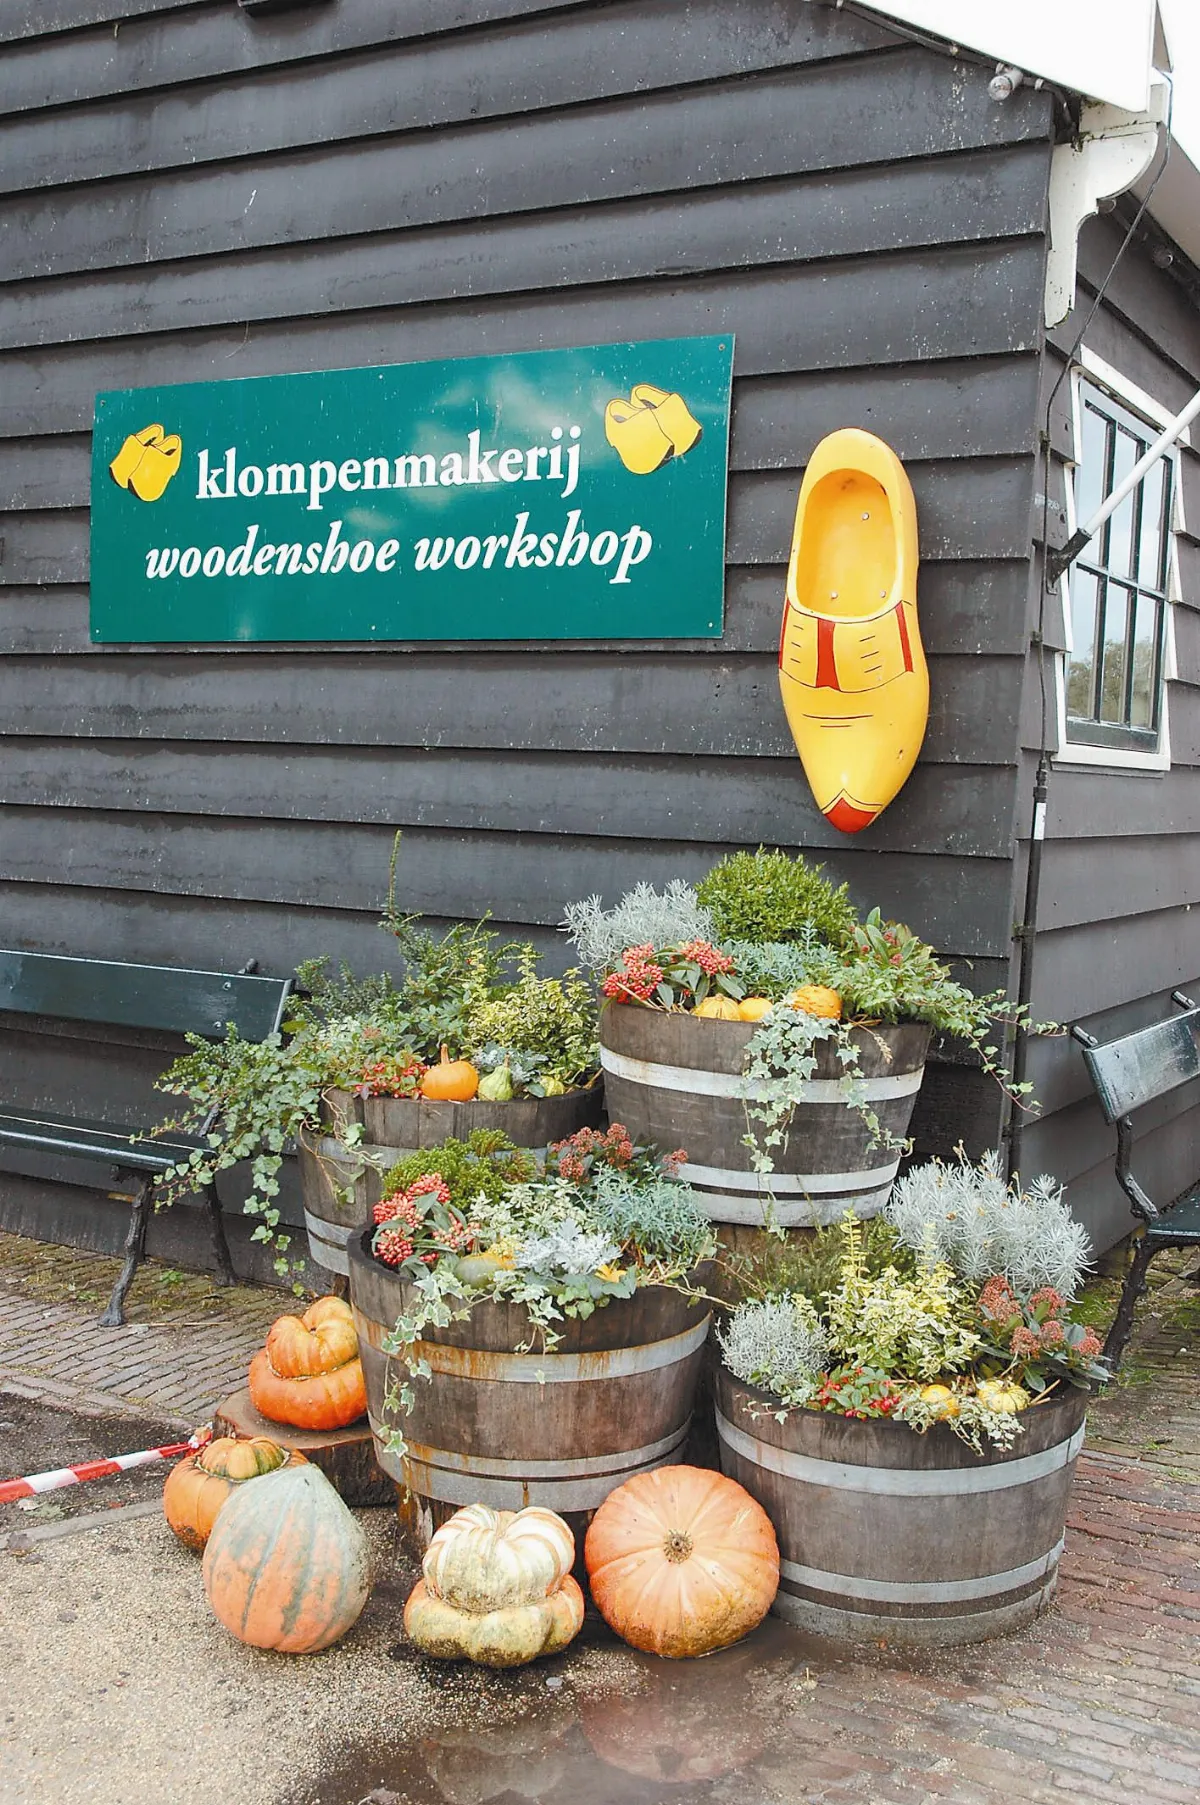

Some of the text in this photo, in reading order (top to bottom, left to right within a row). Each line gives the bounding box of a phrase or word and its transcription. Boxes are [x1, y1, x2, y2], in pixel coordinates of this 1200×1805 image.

[196, 426, 581, 510] klompenmakerij
[145, 510, 653, 584] woodenshoe workshop
